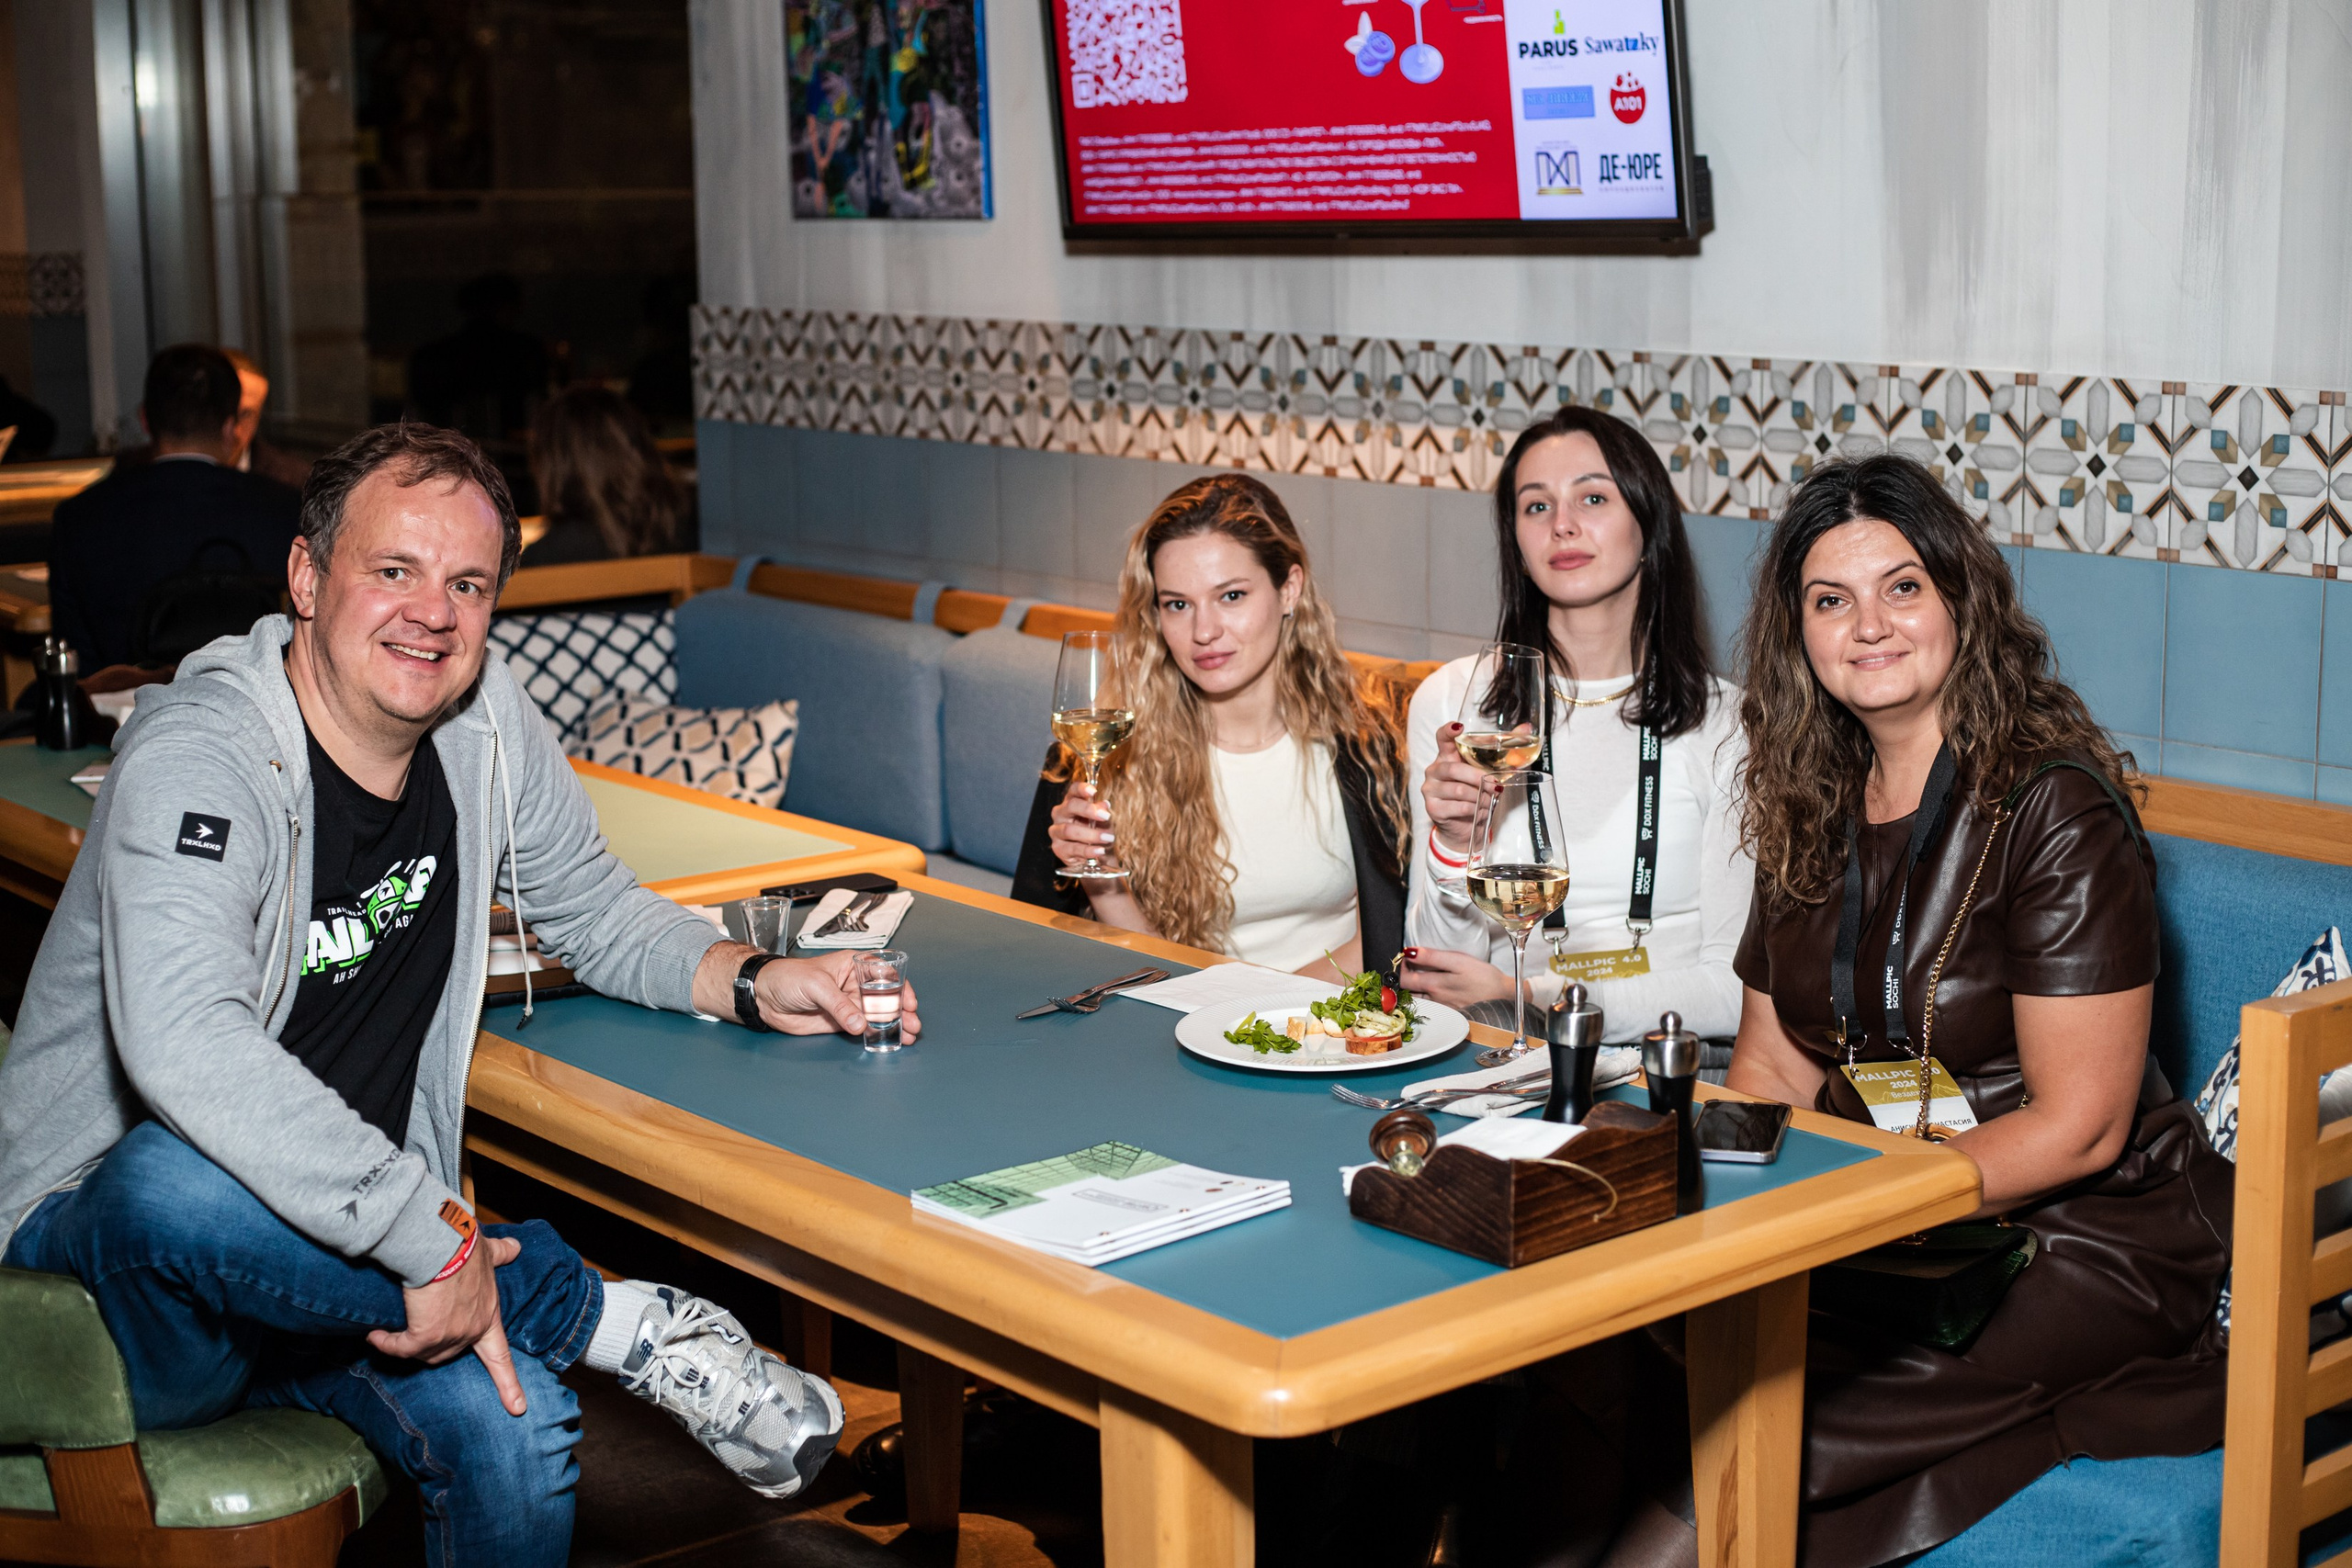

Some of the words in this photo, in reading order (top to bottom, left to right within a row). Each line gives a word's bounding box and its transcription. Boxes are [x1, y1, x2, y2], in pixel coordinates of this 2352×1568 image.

[1519, 39, 1577, 58] PARUS
[1584, 32, 1659, 57] Sawatzky
[1614, 96, 1642, 111] A101
[1599, 153, 1663, 183] ДЕ-ЮРЕ
[1644, 776, 1654, 808] FITNESS
[1532, 804, 1540, 821] DDX
[1643, 809, 1652, 827] DDX
[1534, 821, 1545, 850] FITNESS
[181, 838, 221, 852] TRXLHXD
[1635, 857, 1645, 896] MALLPIC
[1643, 868, 1652, 895] SOCHI
[1555, 957, 1616, 973] MALLPIC
[1622, 954, 1642, 964] 4.0
[1587, 966, 1613, 977] 2024
[333, 971, 346, 985] AH
[1854, 1069, 1916, 1083] MALLPIC
[1889, 1079, 1917, 1089] 2024
[1890, 1090, 1920, 1100] Вездех
